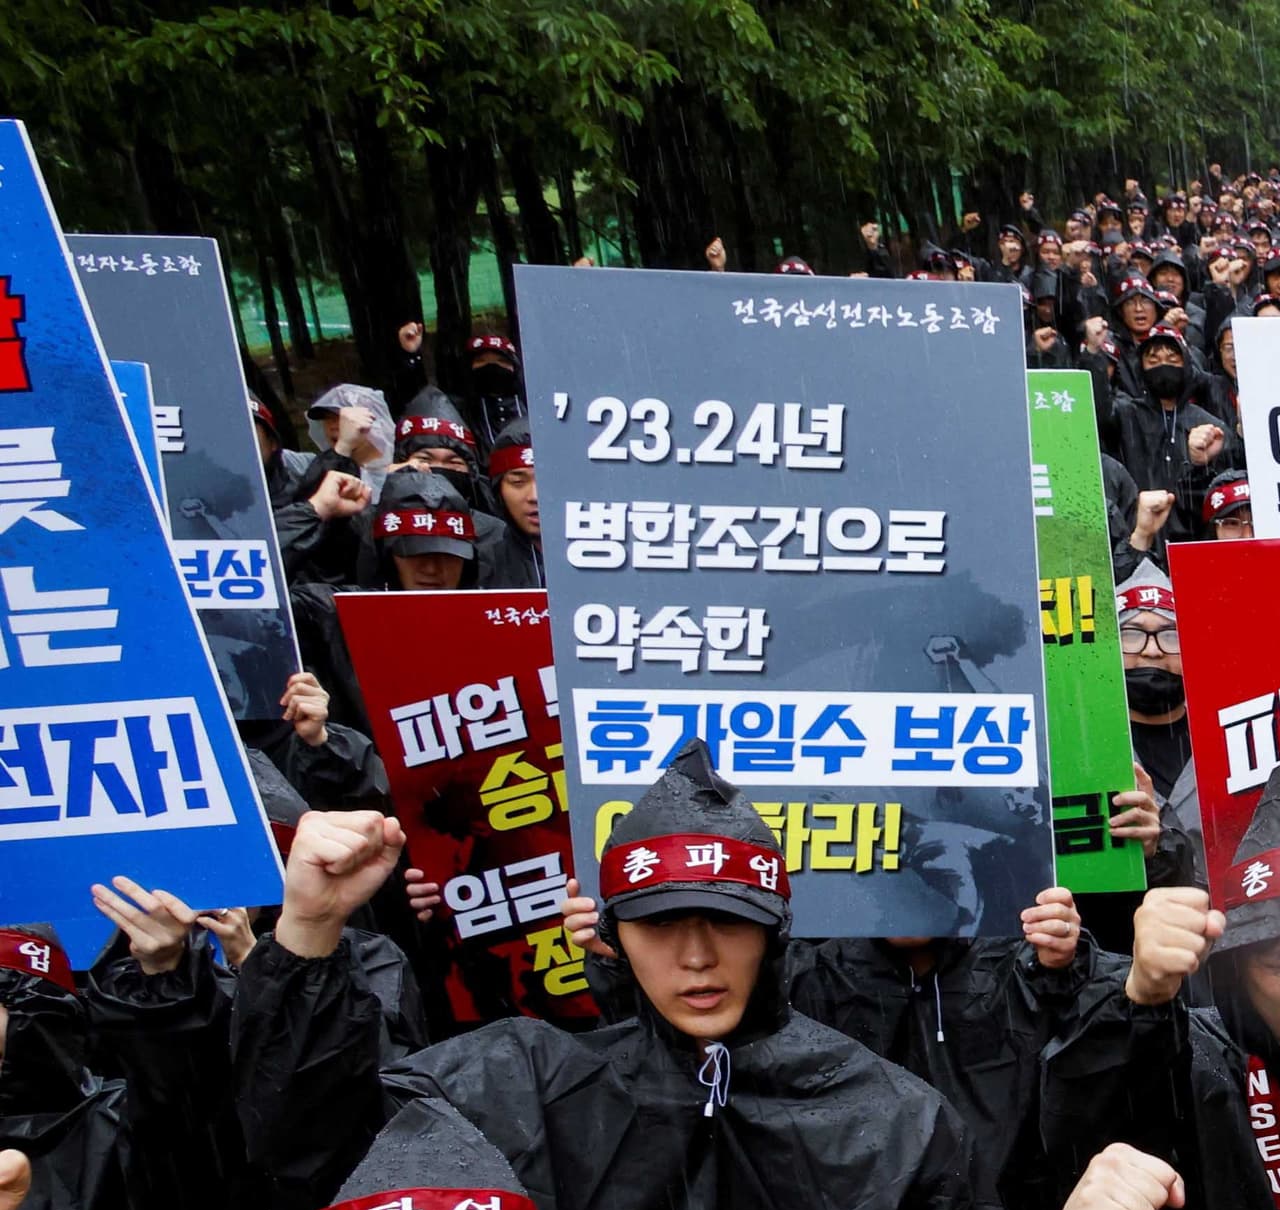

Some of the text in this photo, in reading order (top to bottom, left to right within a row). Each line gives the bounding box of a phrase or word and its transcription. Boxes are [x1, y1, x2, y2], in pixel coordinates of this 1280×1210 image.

[732, 298, 1001, 334] 전국삼성전자노동조합
[383, 511, 465, 536] 총파업
[565, 501, 946, 573] 병합조건으로
[573, 603, 770, 671] 약속한
[390, 676, 527, 768] 파업
[585, 699, 1030, 775] 휴가일수 보상
[444, 853, 568, 939] 임금
[623, 841, 779, 892] 총파업
